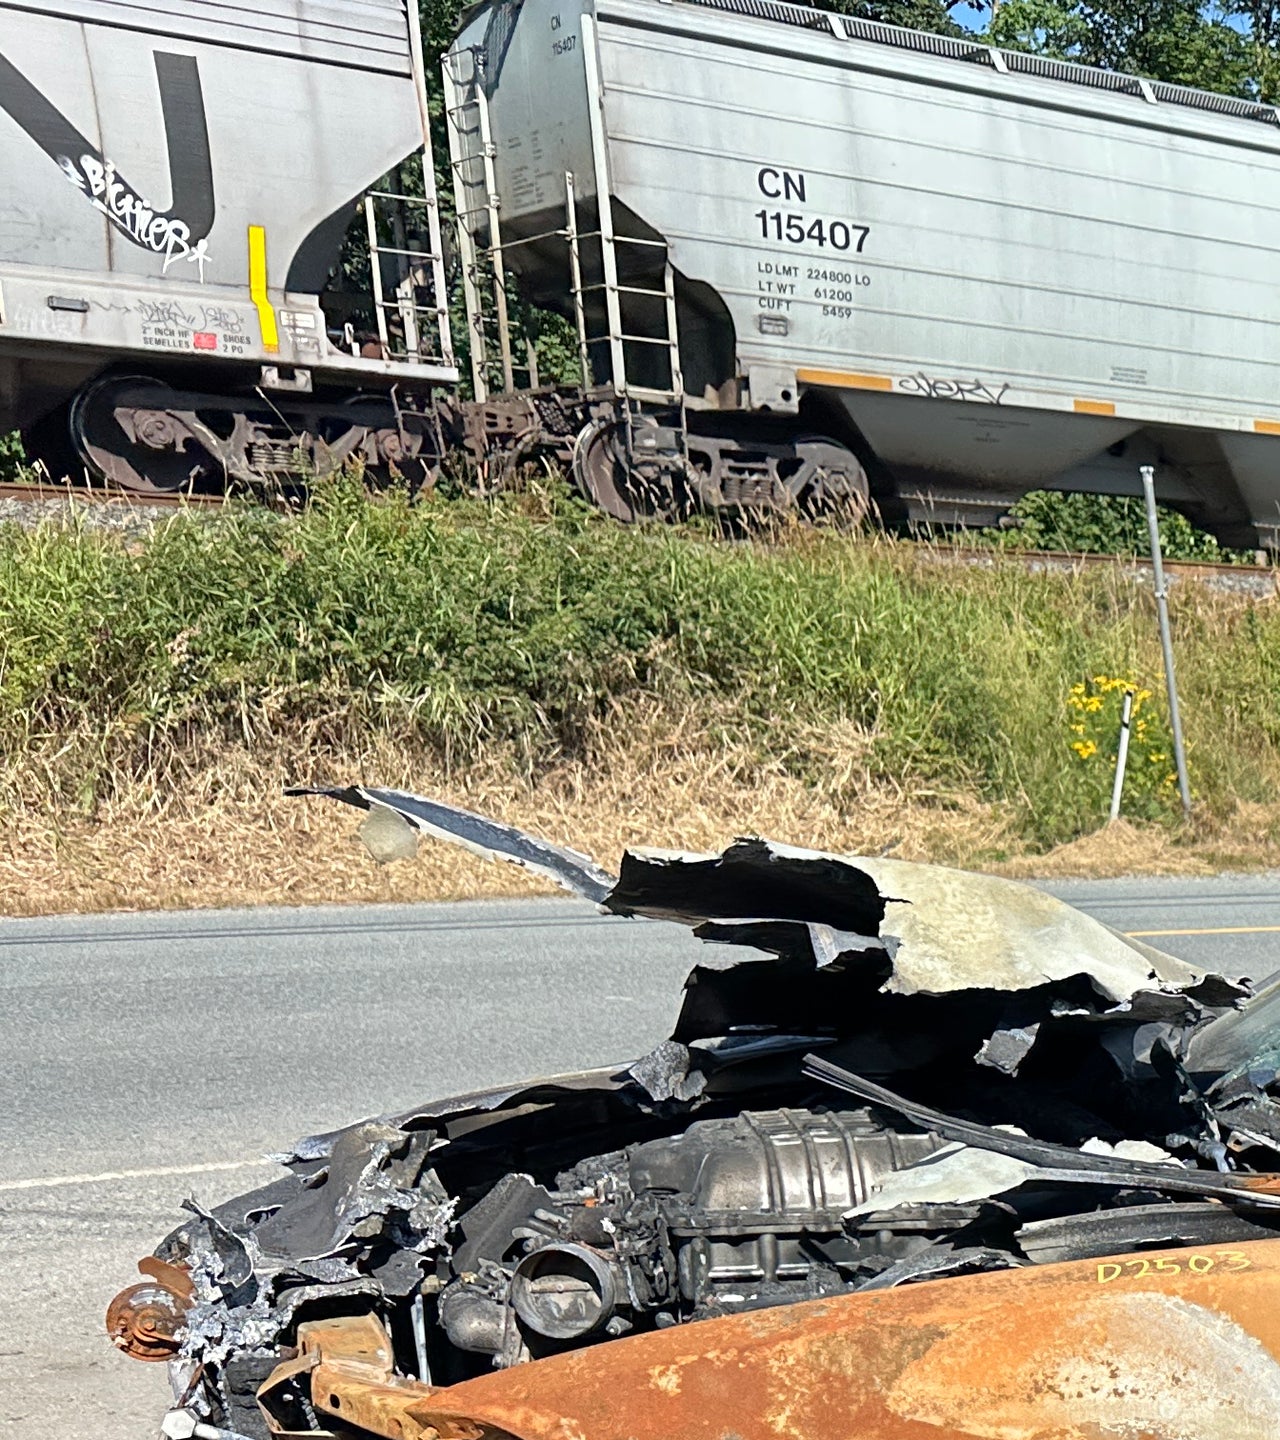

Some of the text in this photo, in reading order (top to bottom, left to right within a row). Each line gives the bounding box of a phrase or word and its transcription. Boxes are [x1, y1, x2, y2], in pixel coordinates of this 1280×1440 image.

[758, 168, 806, 203] CN
[755, 209, 870, 253] 115407
[758, 262, 773, 274] LD
[775, 264, 799, 277] LMT
[807, 268, 851, 284] 224800
[758, 281, 852, 302] LT WT 61200
[822, 306, 852, 319] 5459
[143, 336, 190, 349] SEMELLES
[223, 335, 251, 346] SHOES
[1097, 1250, 1251, 1284] D2503
